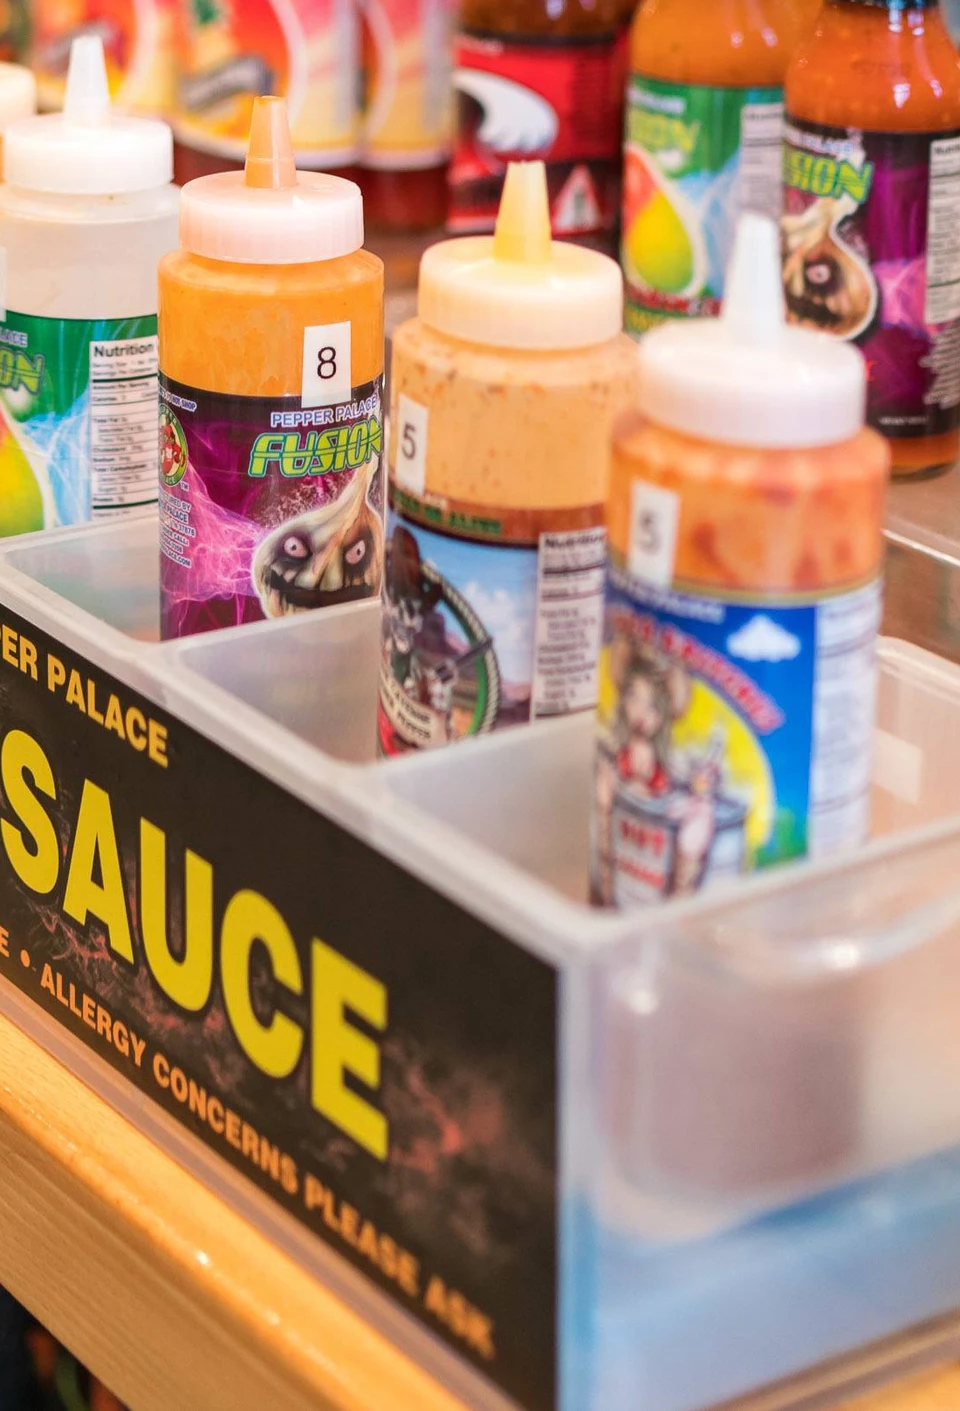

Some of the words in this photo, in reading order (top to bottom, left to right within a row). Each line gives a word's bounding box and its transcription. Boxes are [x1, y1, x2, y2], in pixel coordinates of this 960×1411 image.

[316, 346, 337, 380] 8
[271, 409, 334, 428] PEPPER
[336, 395, 378, 422] PALACE
[401, 423, 416, 460] 5
[248, 414, 382, 478] FUSION
[47, 653, 168, 768] PALACE
[0, 728, 388, 1161] SAUCE
[40, 962, 146, 1067] ALLERGY
[153, 1054, 298, 1194] CONCERNS
[306, 1173, 420, 1297] PLEASE
[425, 1276, 496, 1360] ASK
